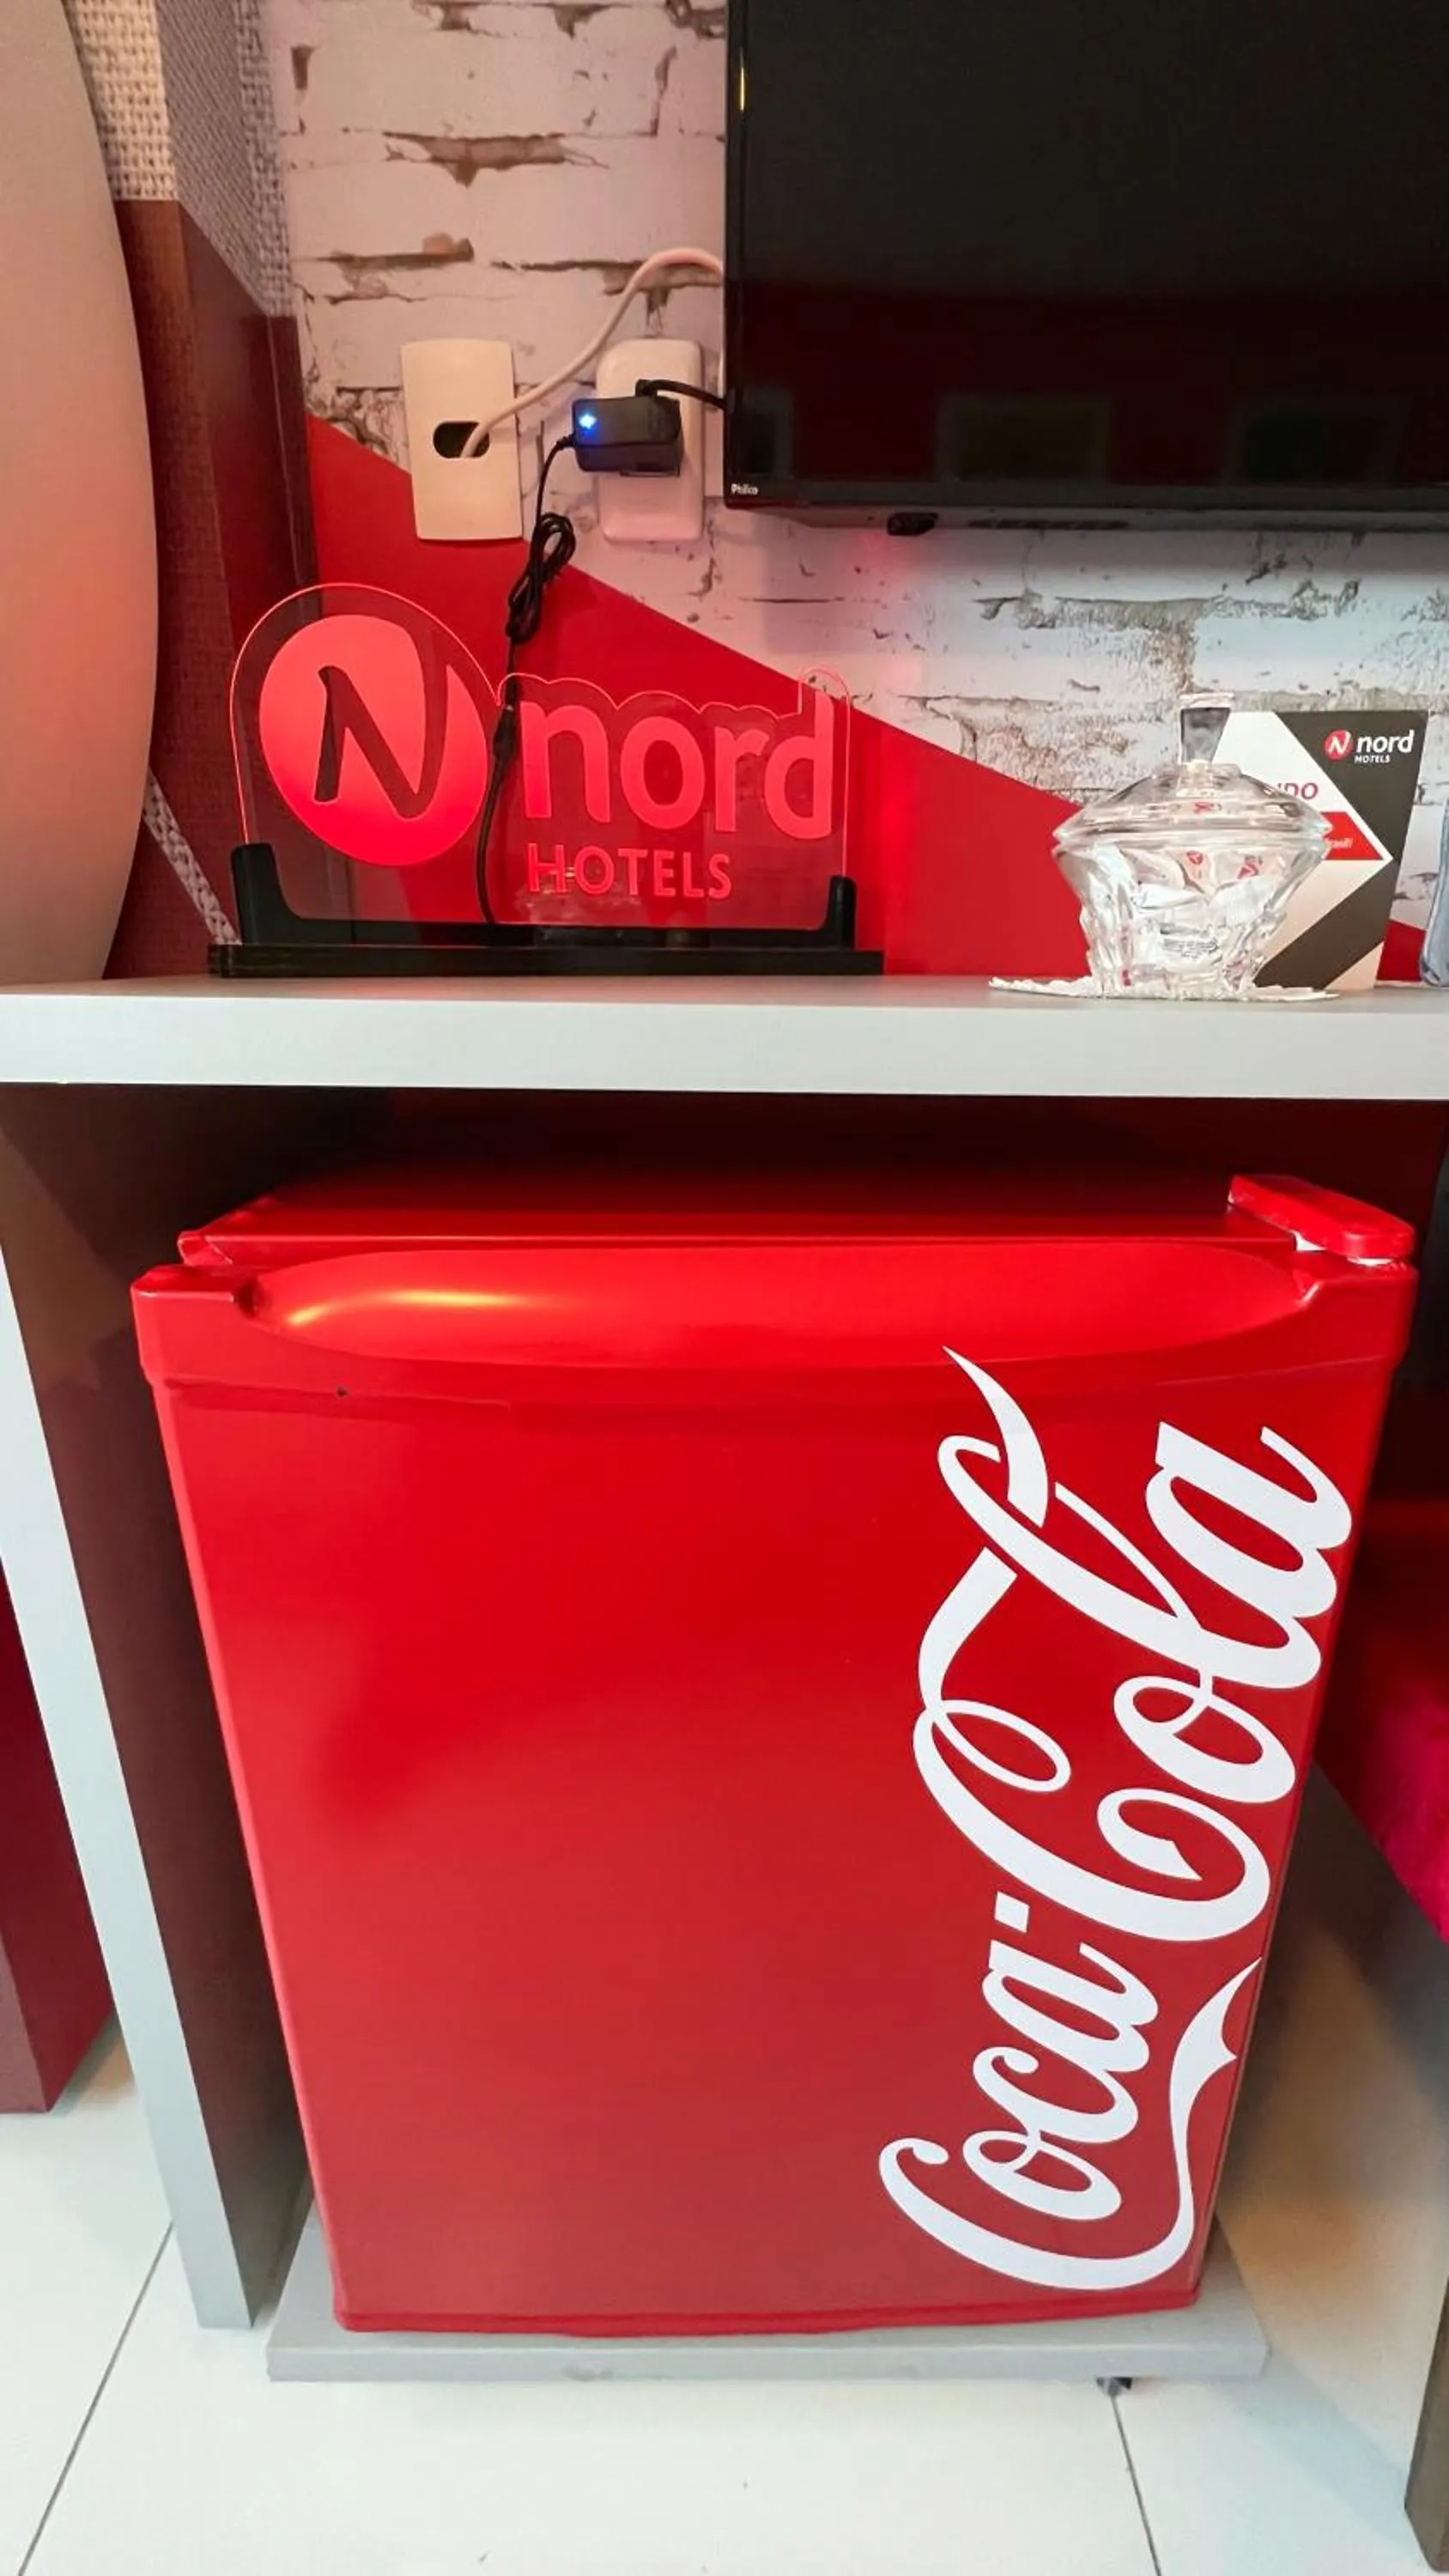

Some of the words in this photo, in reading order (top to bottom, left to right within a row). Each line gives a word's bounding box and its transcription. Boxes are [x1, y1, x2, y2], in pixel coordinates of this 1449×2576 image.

[520, 689, 834, 840] nord
[1356, 729, 1415, 753] nord
[525, 842, 732, 900] HOTELS
[879, 1346, 1353, 2289] Coca-Cola
